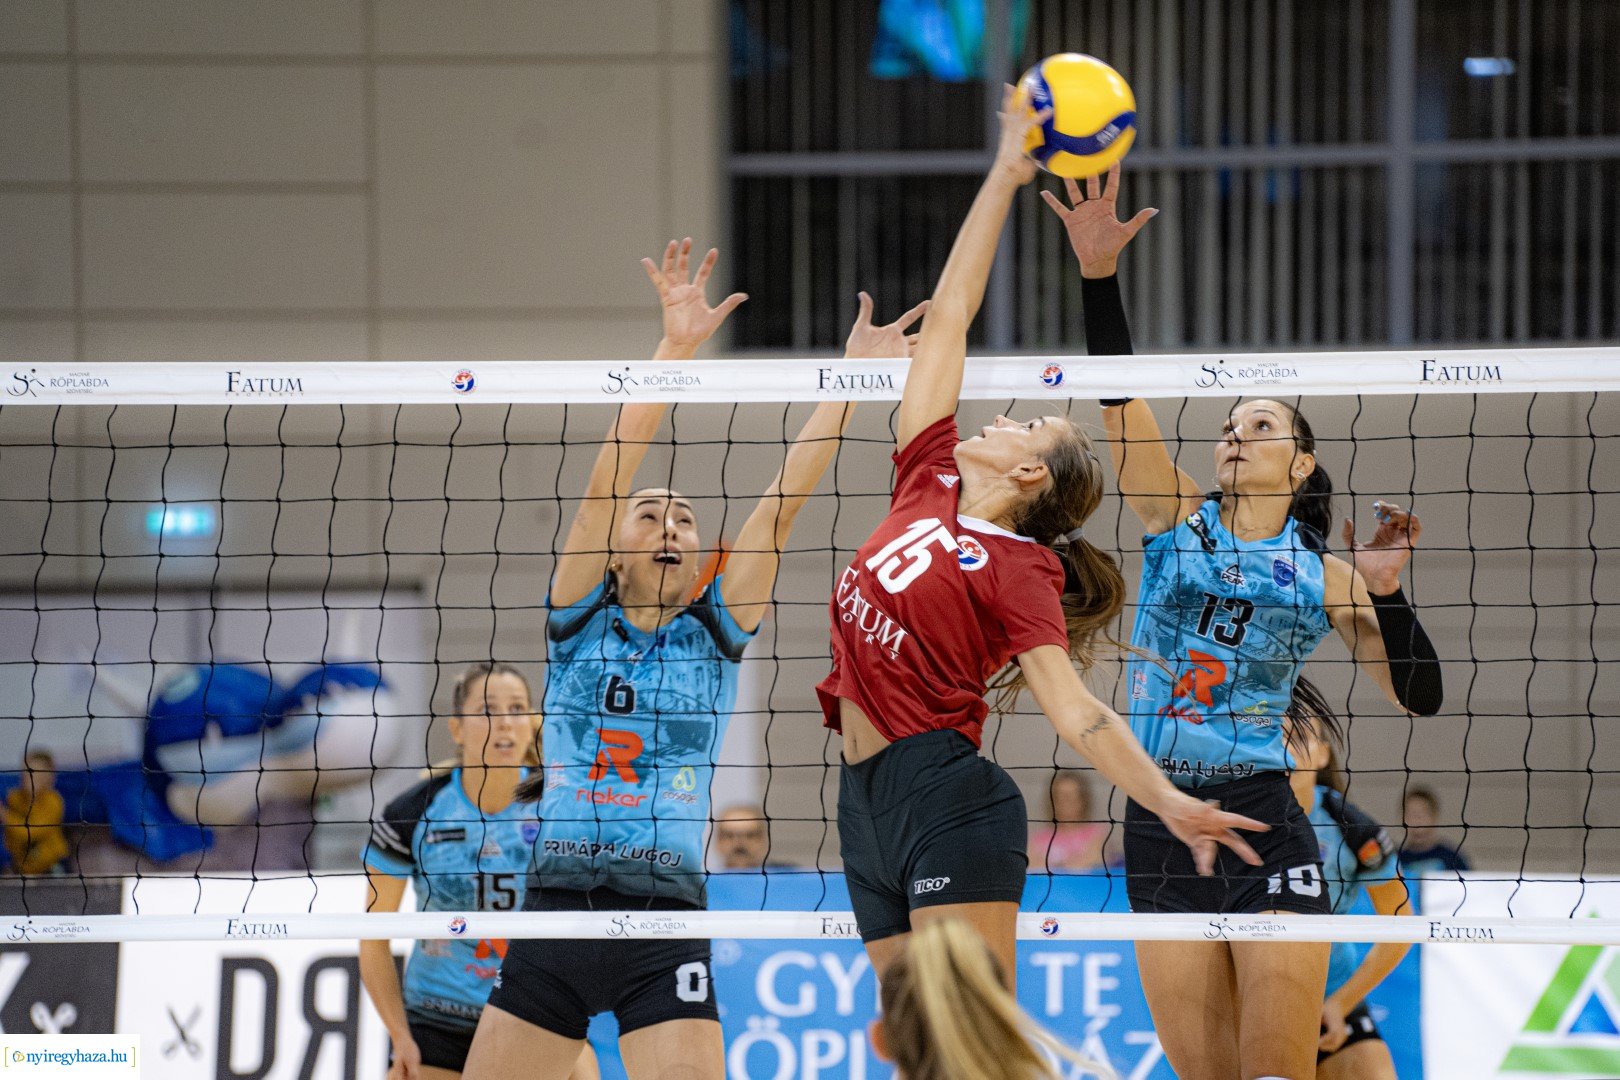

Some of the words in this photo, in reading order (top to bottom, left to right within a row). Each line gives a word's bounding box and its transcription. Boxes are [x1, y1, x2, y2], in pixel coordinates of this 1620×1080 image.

[49, 376, 110, 388] RÖPLABDA
[643, 375, 702, 386] RÖPLABDA
[1238, 366, 1298, 378] RÖPLABDA
[864, 517, 959, 595] 15
[836, 565, 909, 655] FAUM
[1196, 591, 1256, 648] 13
[603, 674, 636, 715] 6
[576, 786, 649, 808] rieker
[619, 844, 683, 867] LUGOJ
[473, 873, 518, 911] 15
[755, 950, 882, 1018] GY
